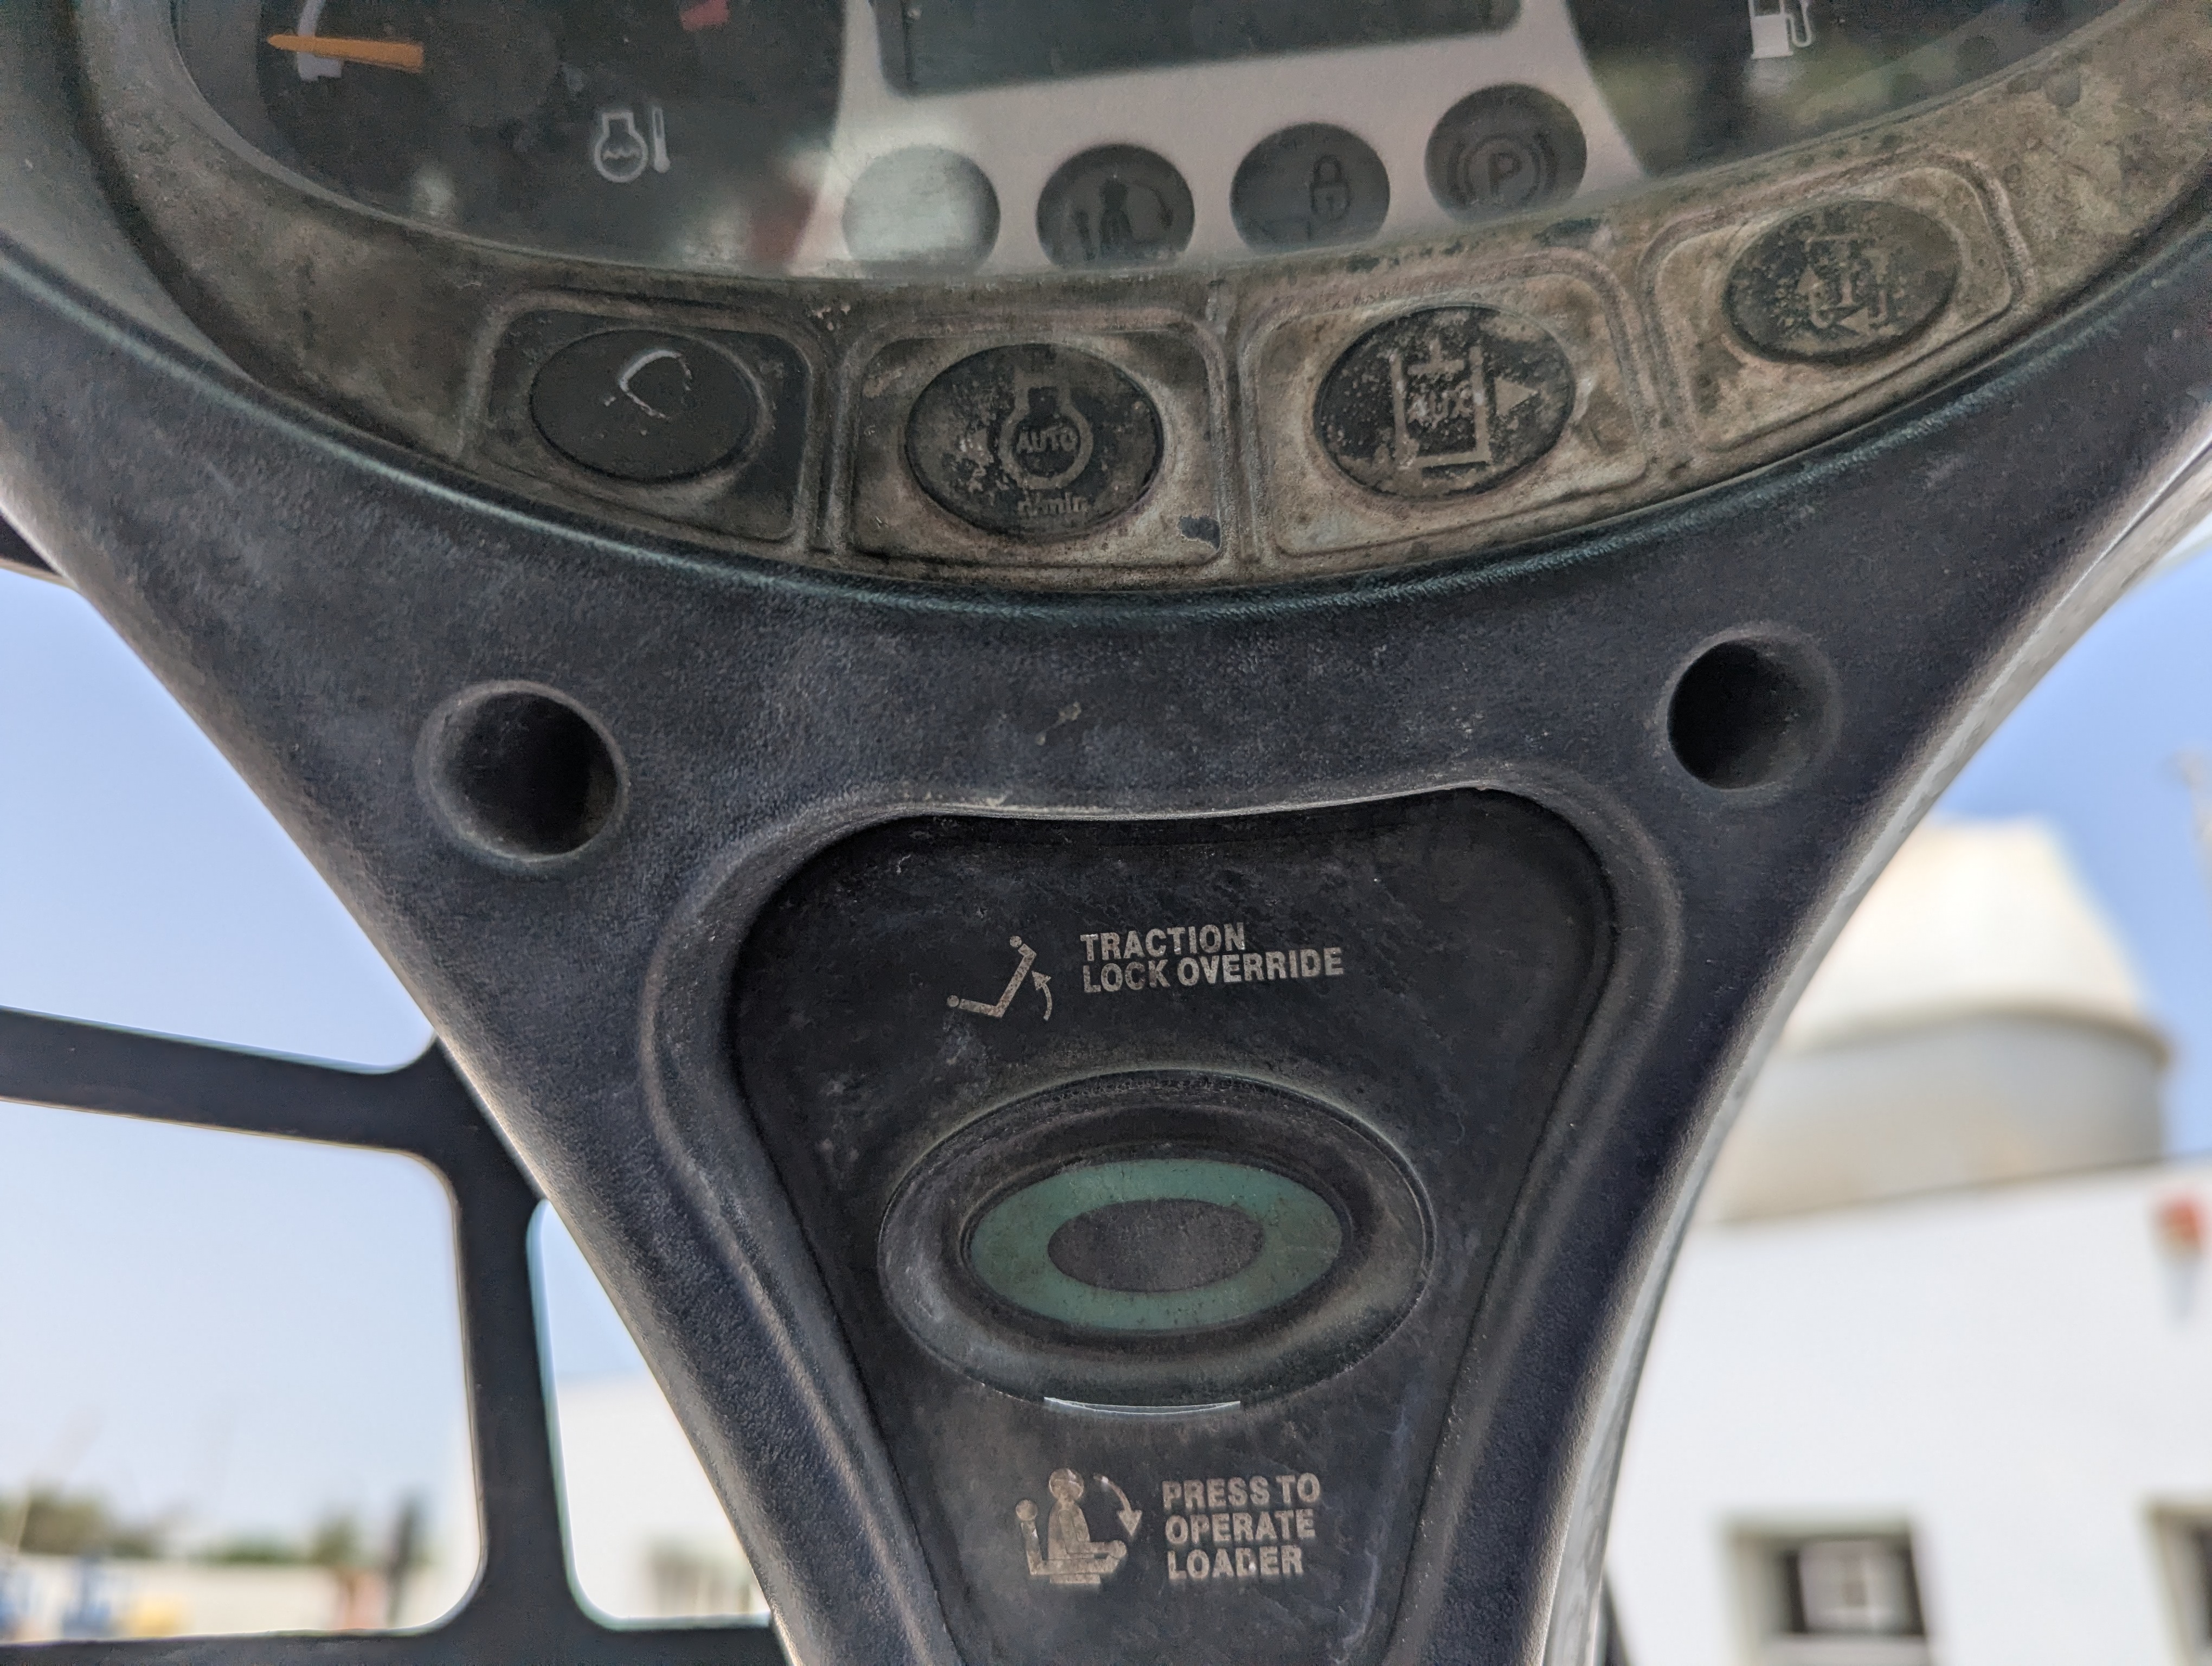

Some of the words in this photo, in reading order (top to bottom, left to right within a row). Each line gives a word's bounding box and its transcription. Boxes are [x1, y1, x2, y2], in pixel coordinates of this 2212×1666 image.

[1488, 153, 1521, 196] P
[1017, 427, 1078, 452] AUTO
[1081, 922, 1245, 961] TRACTION
[1084, 959, 1170, 993] LOCK
[1177, 947, 1344, 985] OVERRIDE
[1162, 1476, 1270, 1509] PRESS
[1276, 1473, 1320, 1504] TO
[1166, 1509, 1315, 1544] OPERATE
[1168, 1545, 1302, 1580] LOADER
